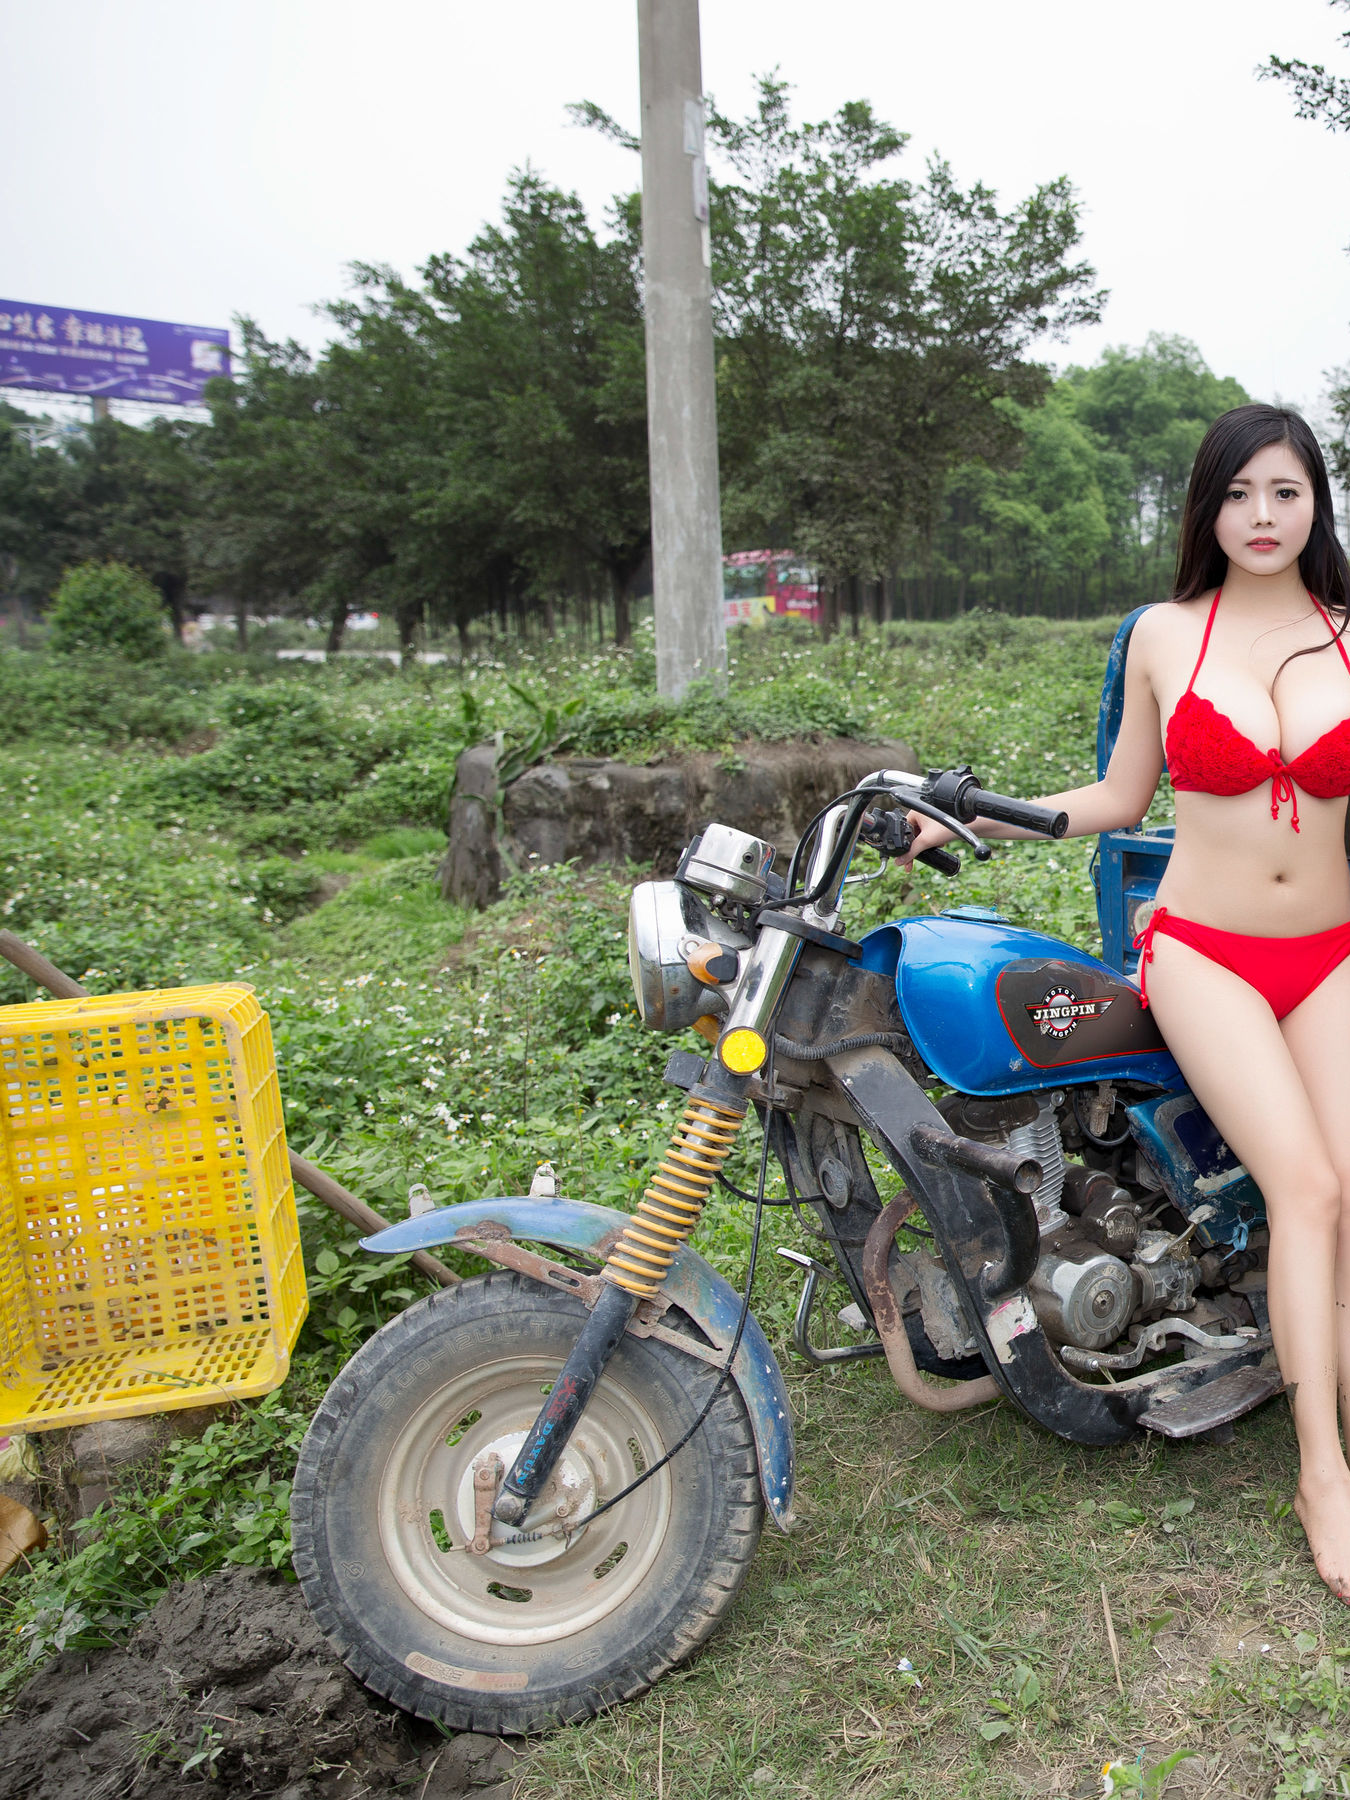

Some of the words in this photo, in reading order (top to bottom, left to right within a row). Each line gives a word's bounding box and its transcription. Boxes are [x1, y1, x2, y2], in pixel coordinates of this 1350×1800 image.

[1045, 987, 1075, 1003] MOTOR
[1033, 1004, 1096, 1020] JINGPIN
[1045, 1021, 1077, 1037] JINGPIN
[516, 1421, 555, 1486] DAYUN
